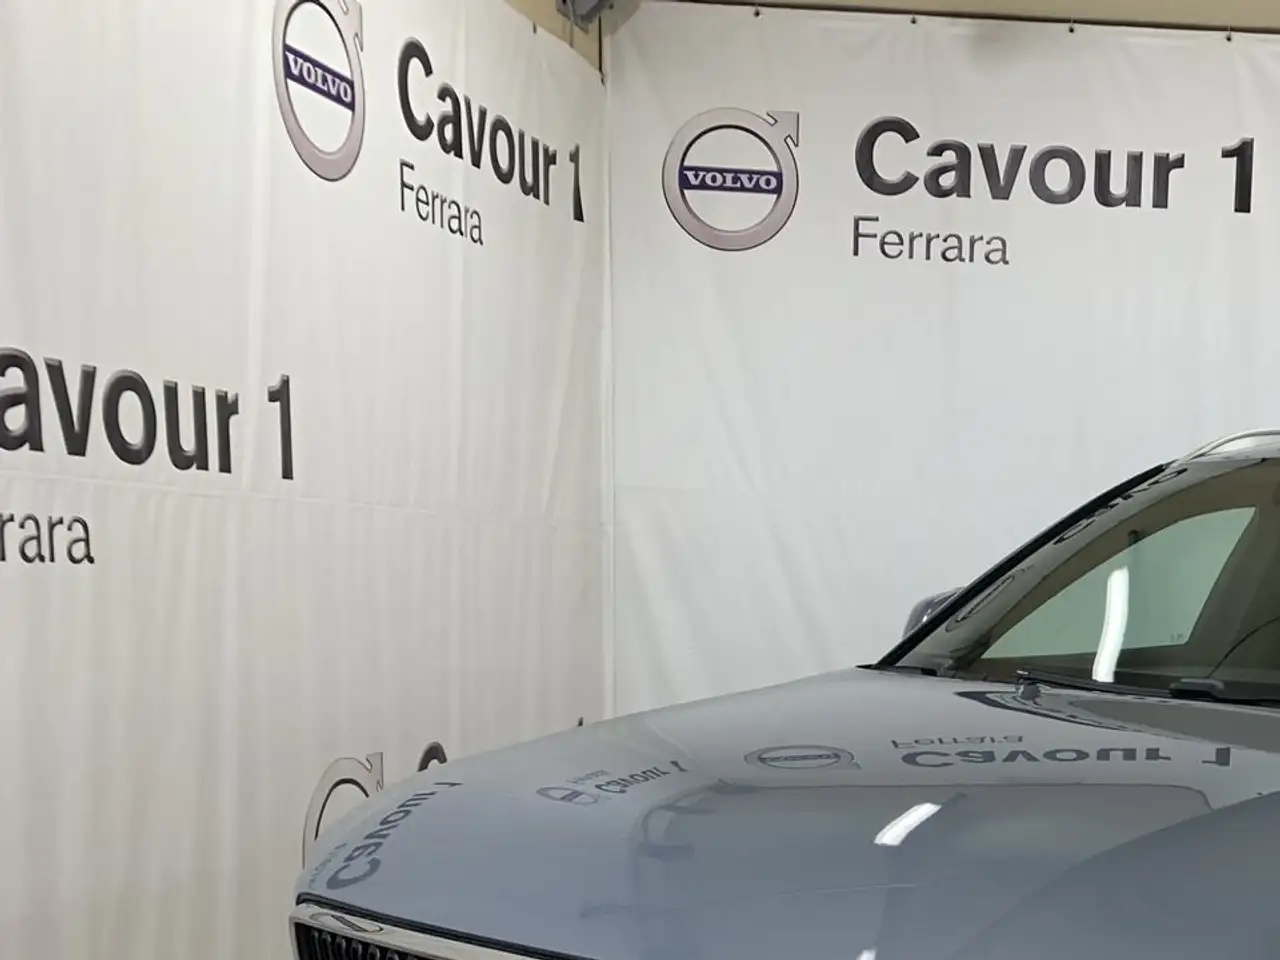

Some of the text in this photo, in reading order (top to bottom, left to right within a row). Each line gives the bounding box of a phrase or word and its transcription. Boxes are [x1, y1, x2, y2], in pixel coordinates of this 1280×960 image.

[285, 51, 351, 103] VOLVO
[397, 36, 584, 222] Cavour 1
[854, 115, 1255, 213] Cavour 1
[399, 158, 483, 246] Ferrara
[683, 170, 777, 190] VOLVO
[852, 215, 1010, 265] Ferrara
[267, 374, 293, 480] 1
